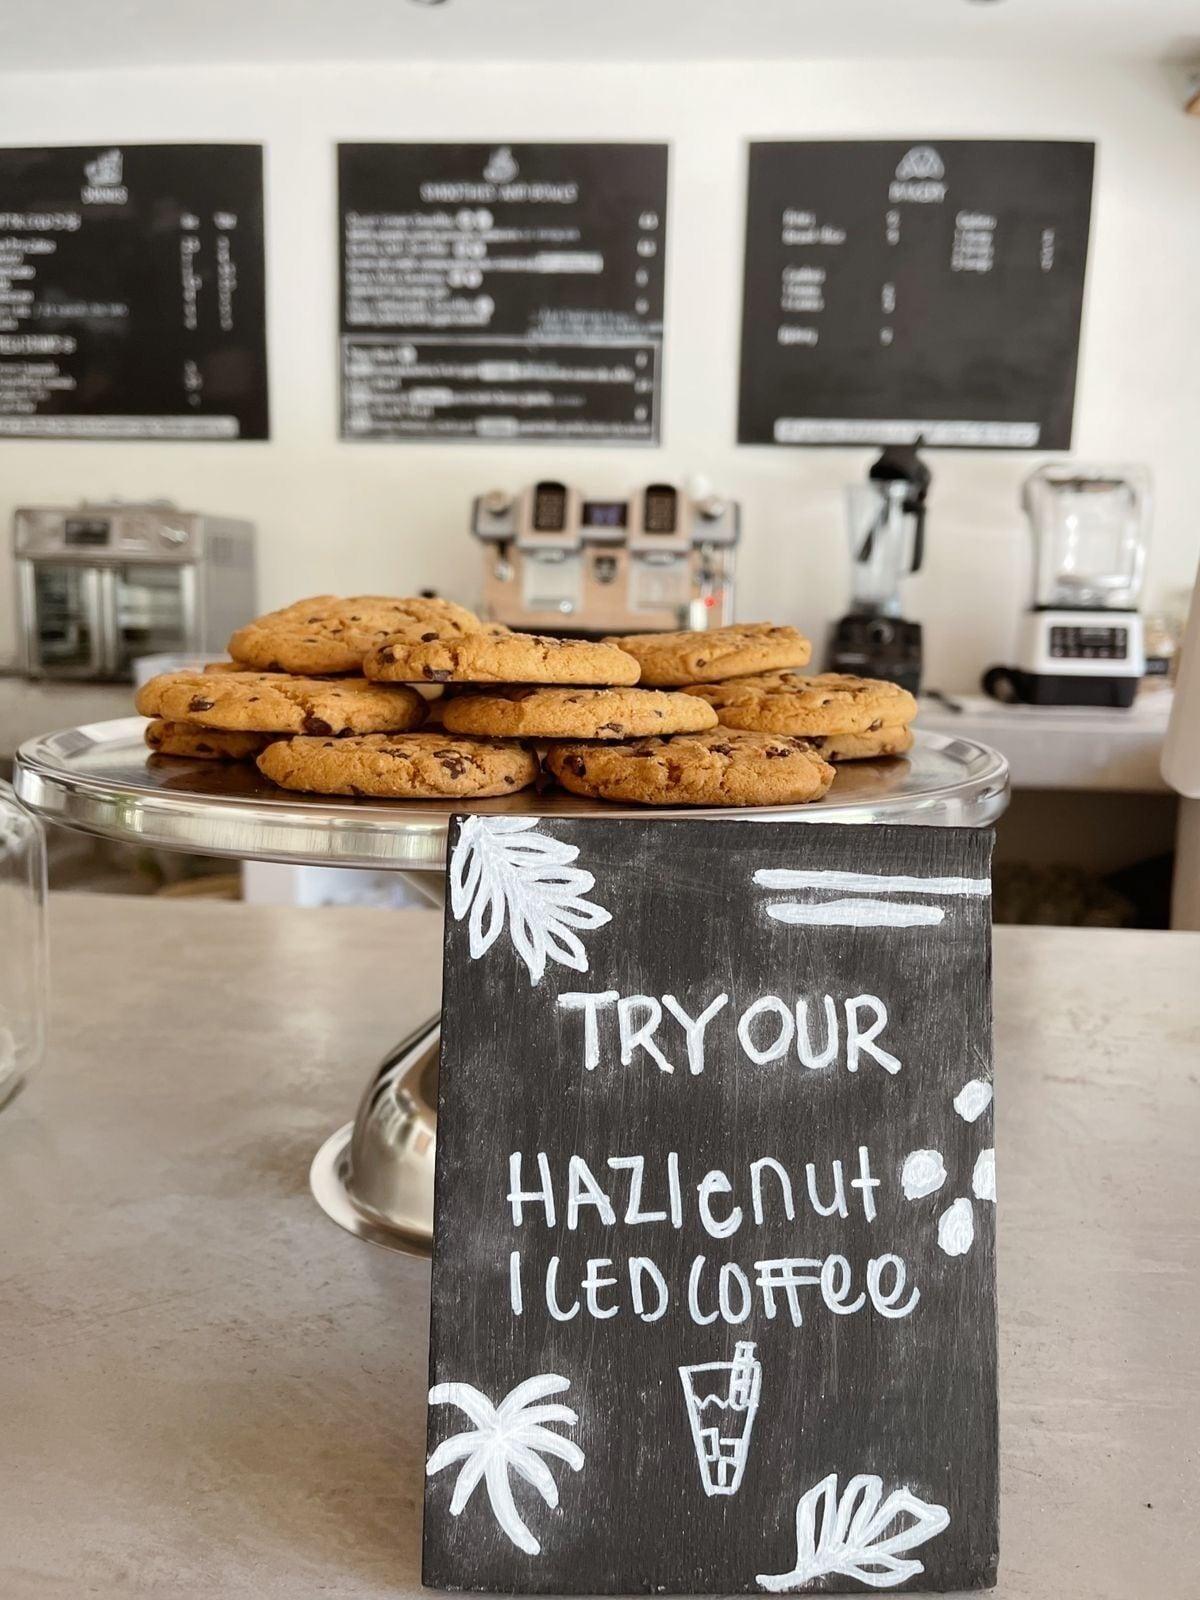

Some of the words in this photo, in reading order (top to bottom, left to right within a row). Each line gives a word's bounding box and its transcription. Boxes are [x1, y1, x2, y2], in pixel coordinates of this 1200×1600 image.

[557, 990, 729, 1075] TRY
[737, 993, 902, 1075] OUR
[510, 1251, 669, 1323] ICED
